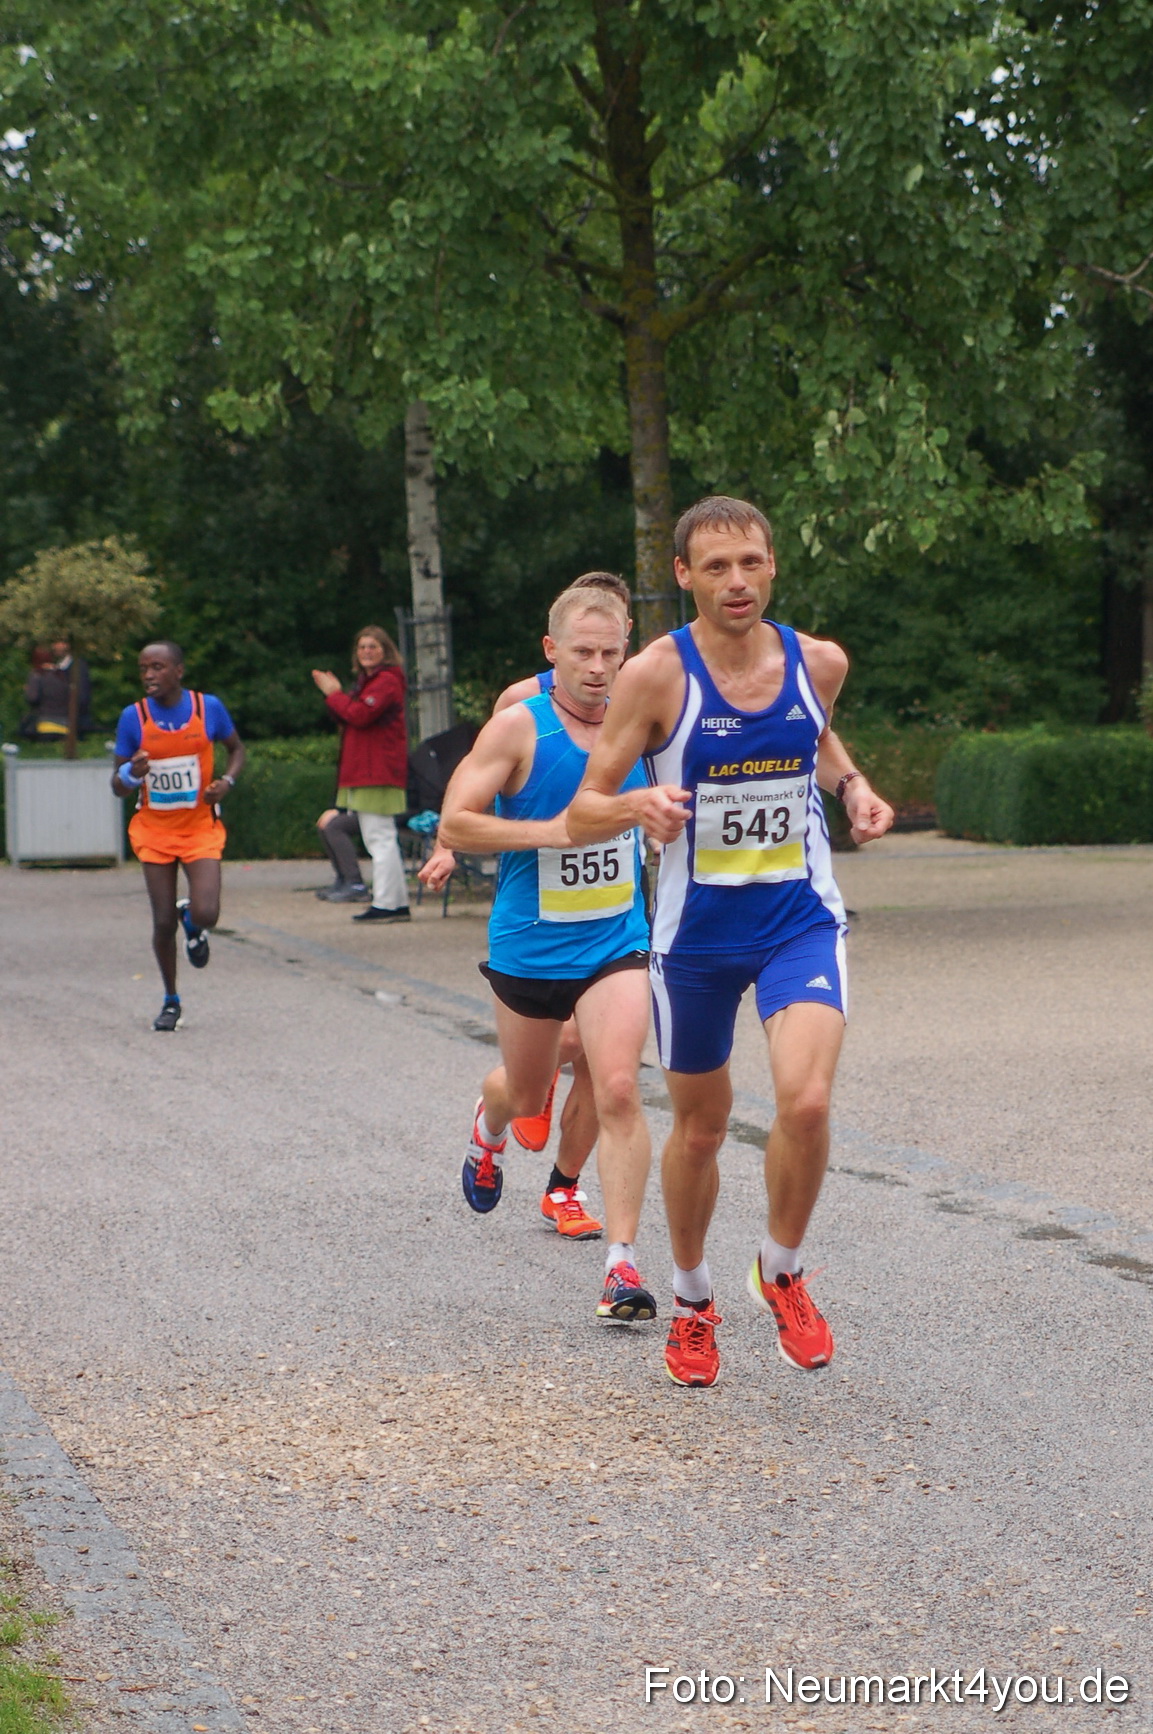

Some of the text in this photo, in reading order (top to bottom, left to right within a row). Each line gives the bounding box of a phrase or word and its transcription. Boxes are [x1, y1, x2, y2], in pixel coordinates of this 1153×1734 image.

[701, 717, 742, 729] HEITEC
[708, 758, 802, 777] LAC QUELLE
[149, 770, 193, 790] 2001
[699, 790, 794, 804] PARTL Neumarkt
[721, 806, 791, 846] 543
[560, 848, 619, 886] 555
